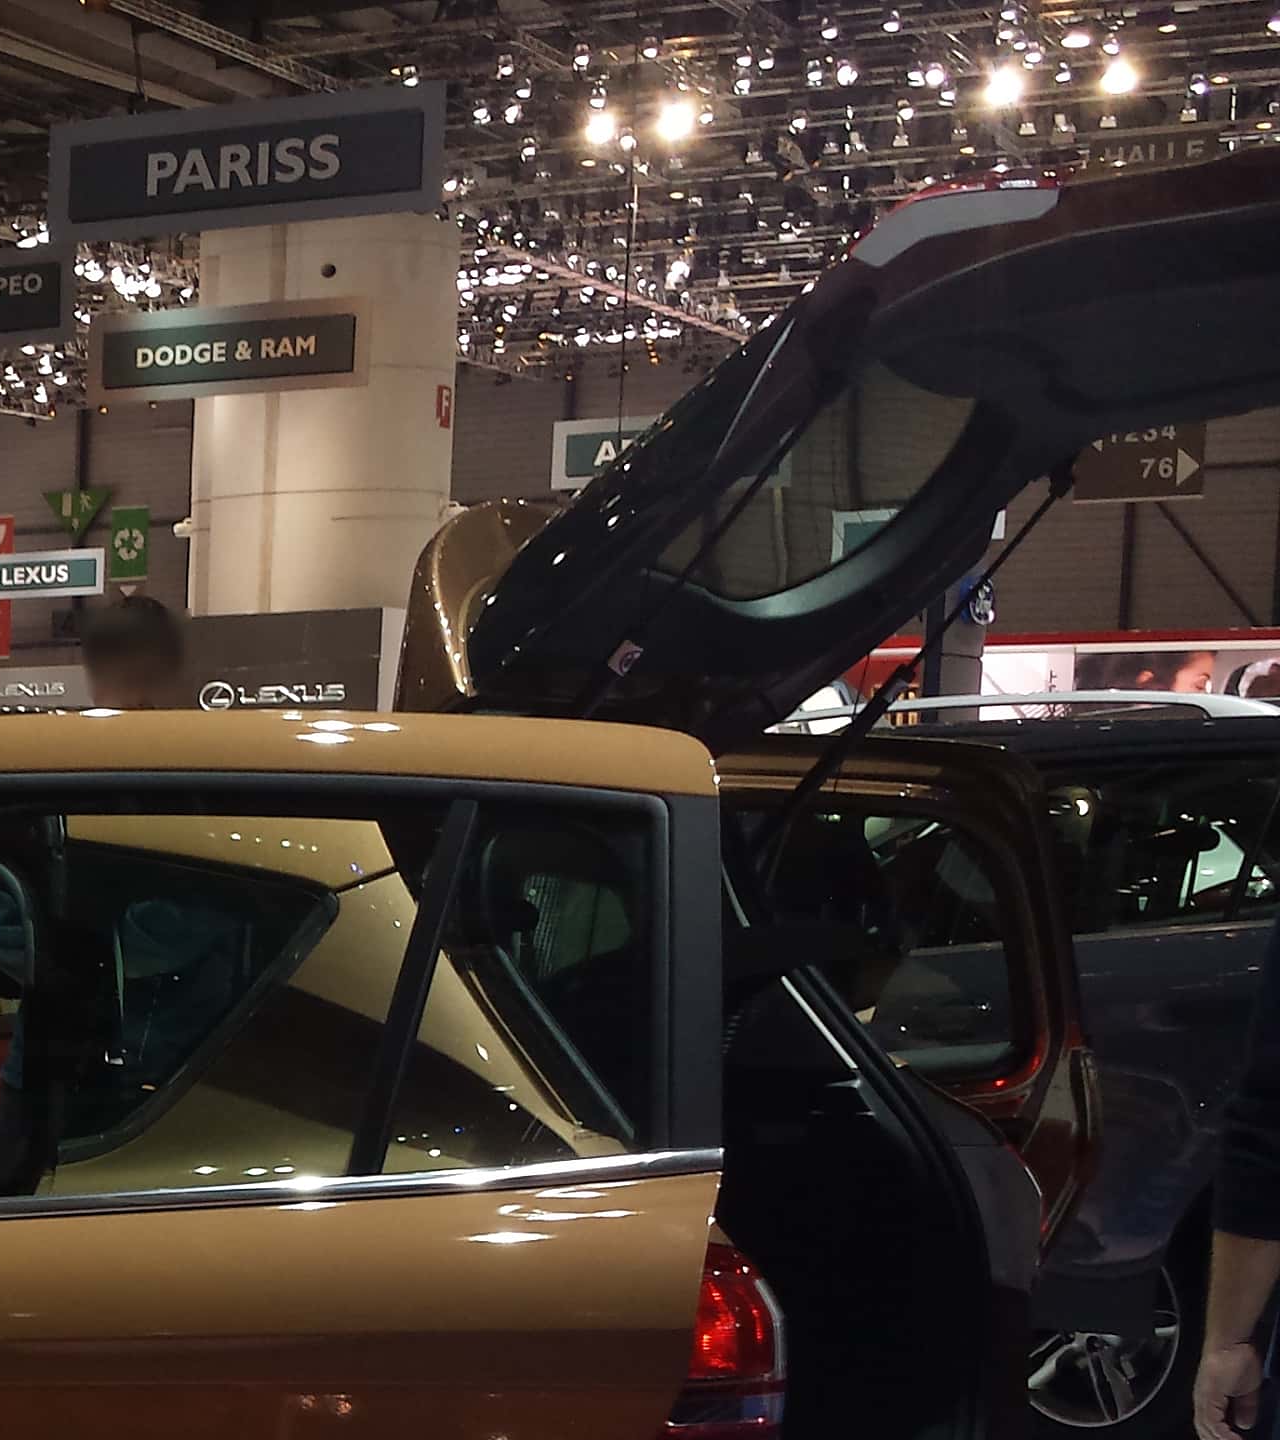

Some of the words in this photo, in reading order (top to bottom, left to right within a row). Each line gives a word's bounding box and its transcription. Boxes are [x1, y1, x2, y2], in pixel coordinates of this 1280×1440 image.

[145, 133, 341, 198] PARISS
[135, 341, 227, 369] DODGE
[234, 339, 253, 361] &
[260, 334, 318, 360] RAM
[1139, 457, 1175, 480] 76
[0, 563, 69, 586] LEXUS
[237, 683, 347, 704] LEXUS
